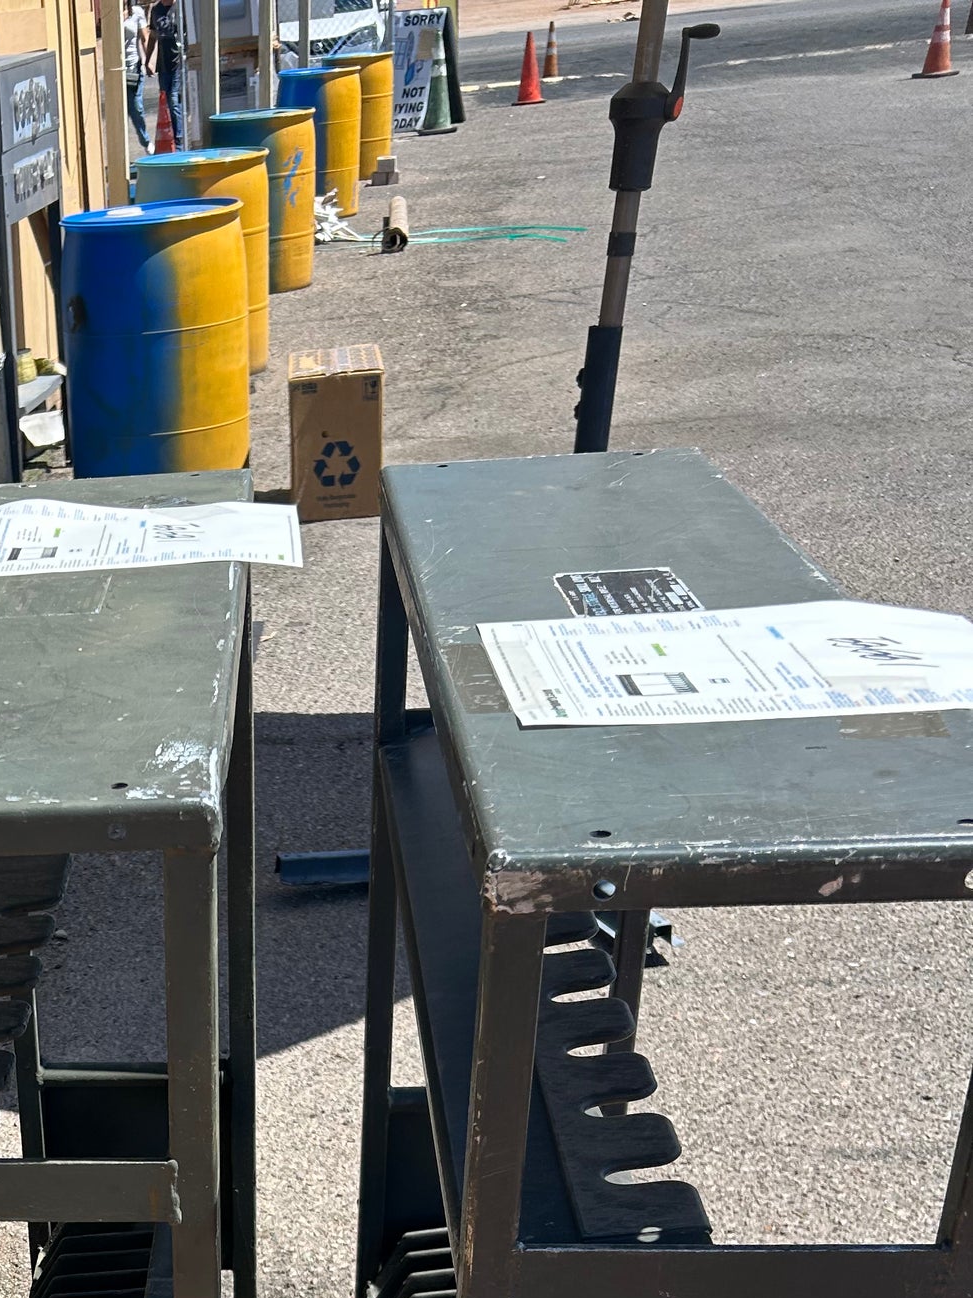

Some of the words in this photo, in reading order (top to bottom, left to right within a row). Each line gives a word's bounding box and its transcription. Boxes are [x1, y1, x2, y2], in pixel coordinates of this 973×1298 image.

[404, 13, 443, 27] SORRY
[401, 86, 425, 99] NOT
[394, 101, 425, 114] YING
